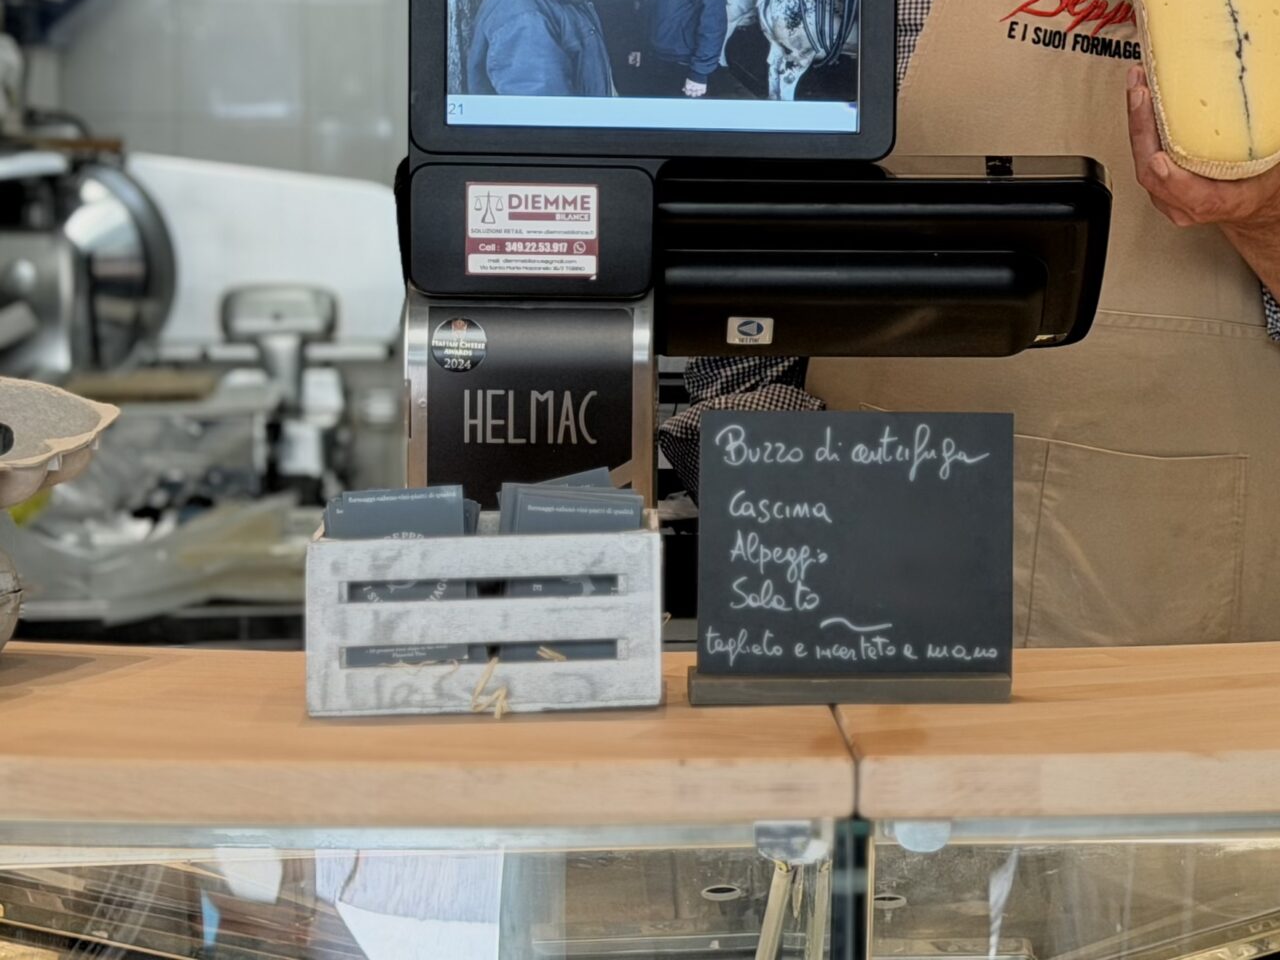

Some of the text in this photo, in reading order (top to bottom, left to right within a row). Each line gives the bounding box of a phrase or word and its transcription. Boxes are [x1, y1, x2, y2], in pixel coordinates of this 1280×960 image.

[1007, 21, 1142, 60] E I SUOI FORMAGG
[448, 102, 464, 116] 21
[508, 193, 592, 211] DIEMME
[555, 212, 590, 221] BILANCE
[504, 241, 568, 253] 349.22.53.917
[443, 357, 472, 370] 2024
[464, 389, 598, 445] HELMAC
[815, 425, 842, 463] di
[730, 529, 829, 583] Alpeggio
[794, 643, 809, 659] e
